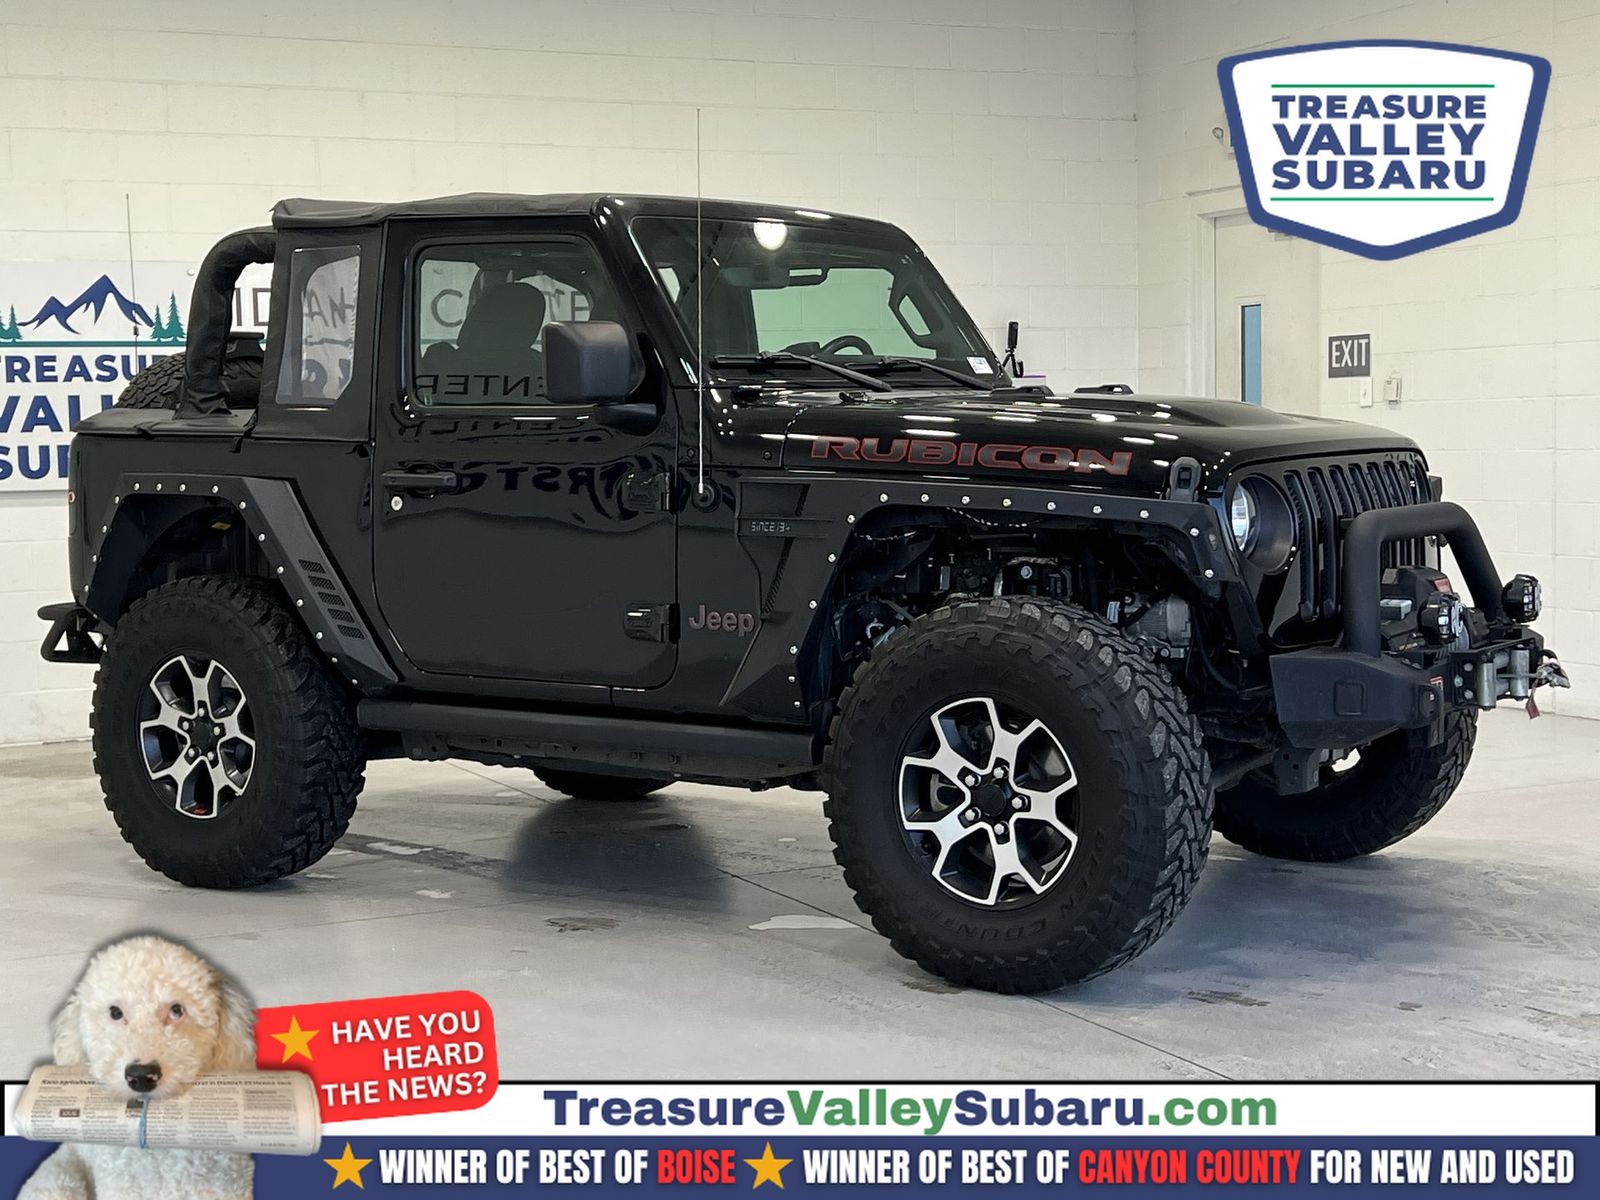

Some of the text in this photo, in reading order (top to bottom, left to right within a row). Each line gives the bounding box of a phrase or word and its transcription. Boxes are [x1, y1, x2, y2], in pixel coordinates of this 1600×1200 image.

[0, 354, 172, 383] REASU
[1332, 339, 1369, 368] EXIT
[811, 436, 1133, 476] RUBICON
[688, 605, 755, 637] Jeep
